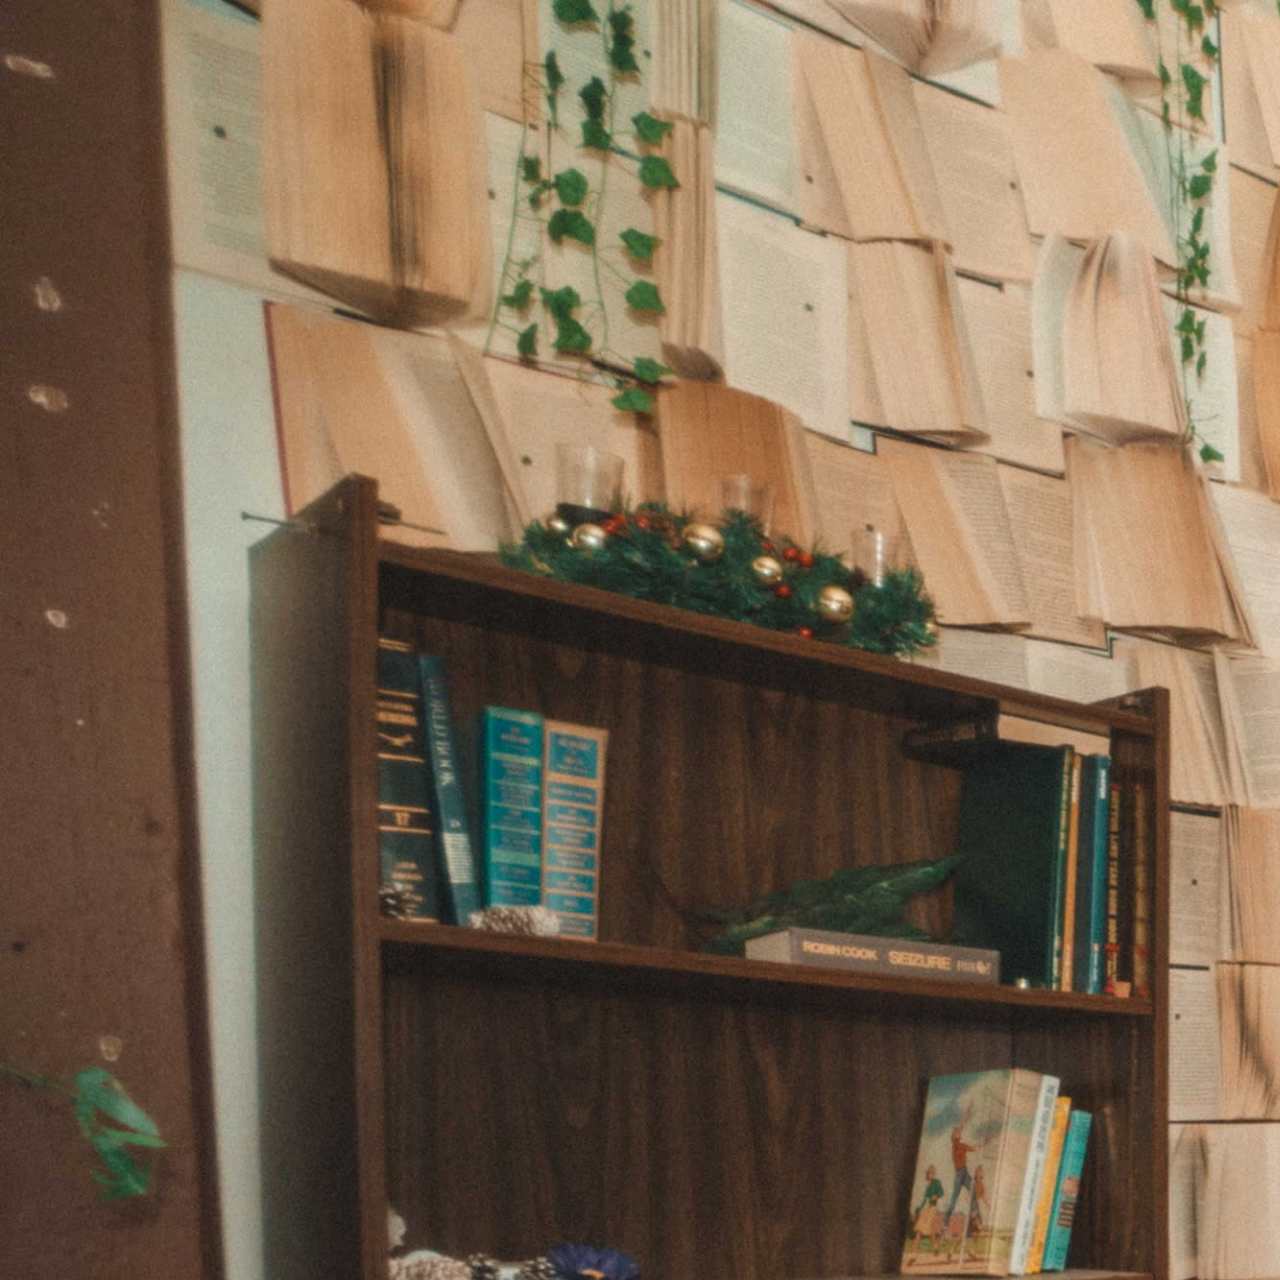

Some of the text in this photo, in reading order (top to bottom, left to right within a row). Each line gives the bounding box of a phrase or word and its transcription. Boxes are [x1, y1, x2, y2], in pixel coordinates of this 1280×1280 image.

[802, 939, 878, 961] ROBIN COOK
[888, 949, 952, 971] SEIZURE
